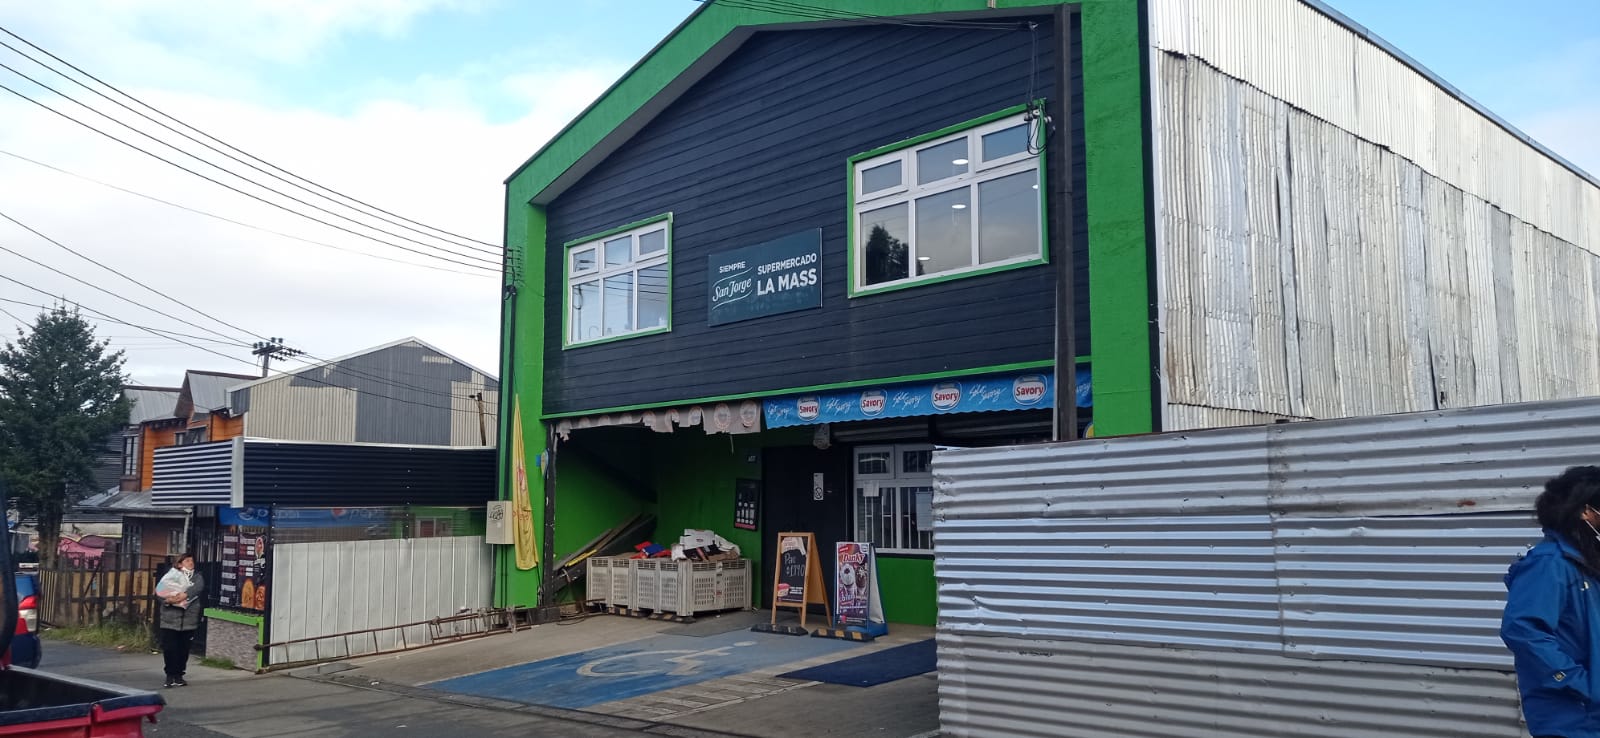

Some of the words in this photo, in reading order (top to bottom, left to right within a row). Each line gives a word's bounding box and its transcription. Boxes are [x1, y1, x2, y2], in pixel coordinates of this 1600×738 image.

[719, 261, 746, 273] SIEMPRE
[757, 253, 817, 275] SUPERMERCADO
[757, 278, 775, 296] LA
[778, 268, 817, 292] MASS
[712, 285, 729, 302] San
[728, 278, 752, 297] Jorge
[934, 392, 959, 402] Savory
[1015, 386, 1044, 397] Savory
[862, 399, 884, 408] Savory
[799, 405, 818, 414] Savory
